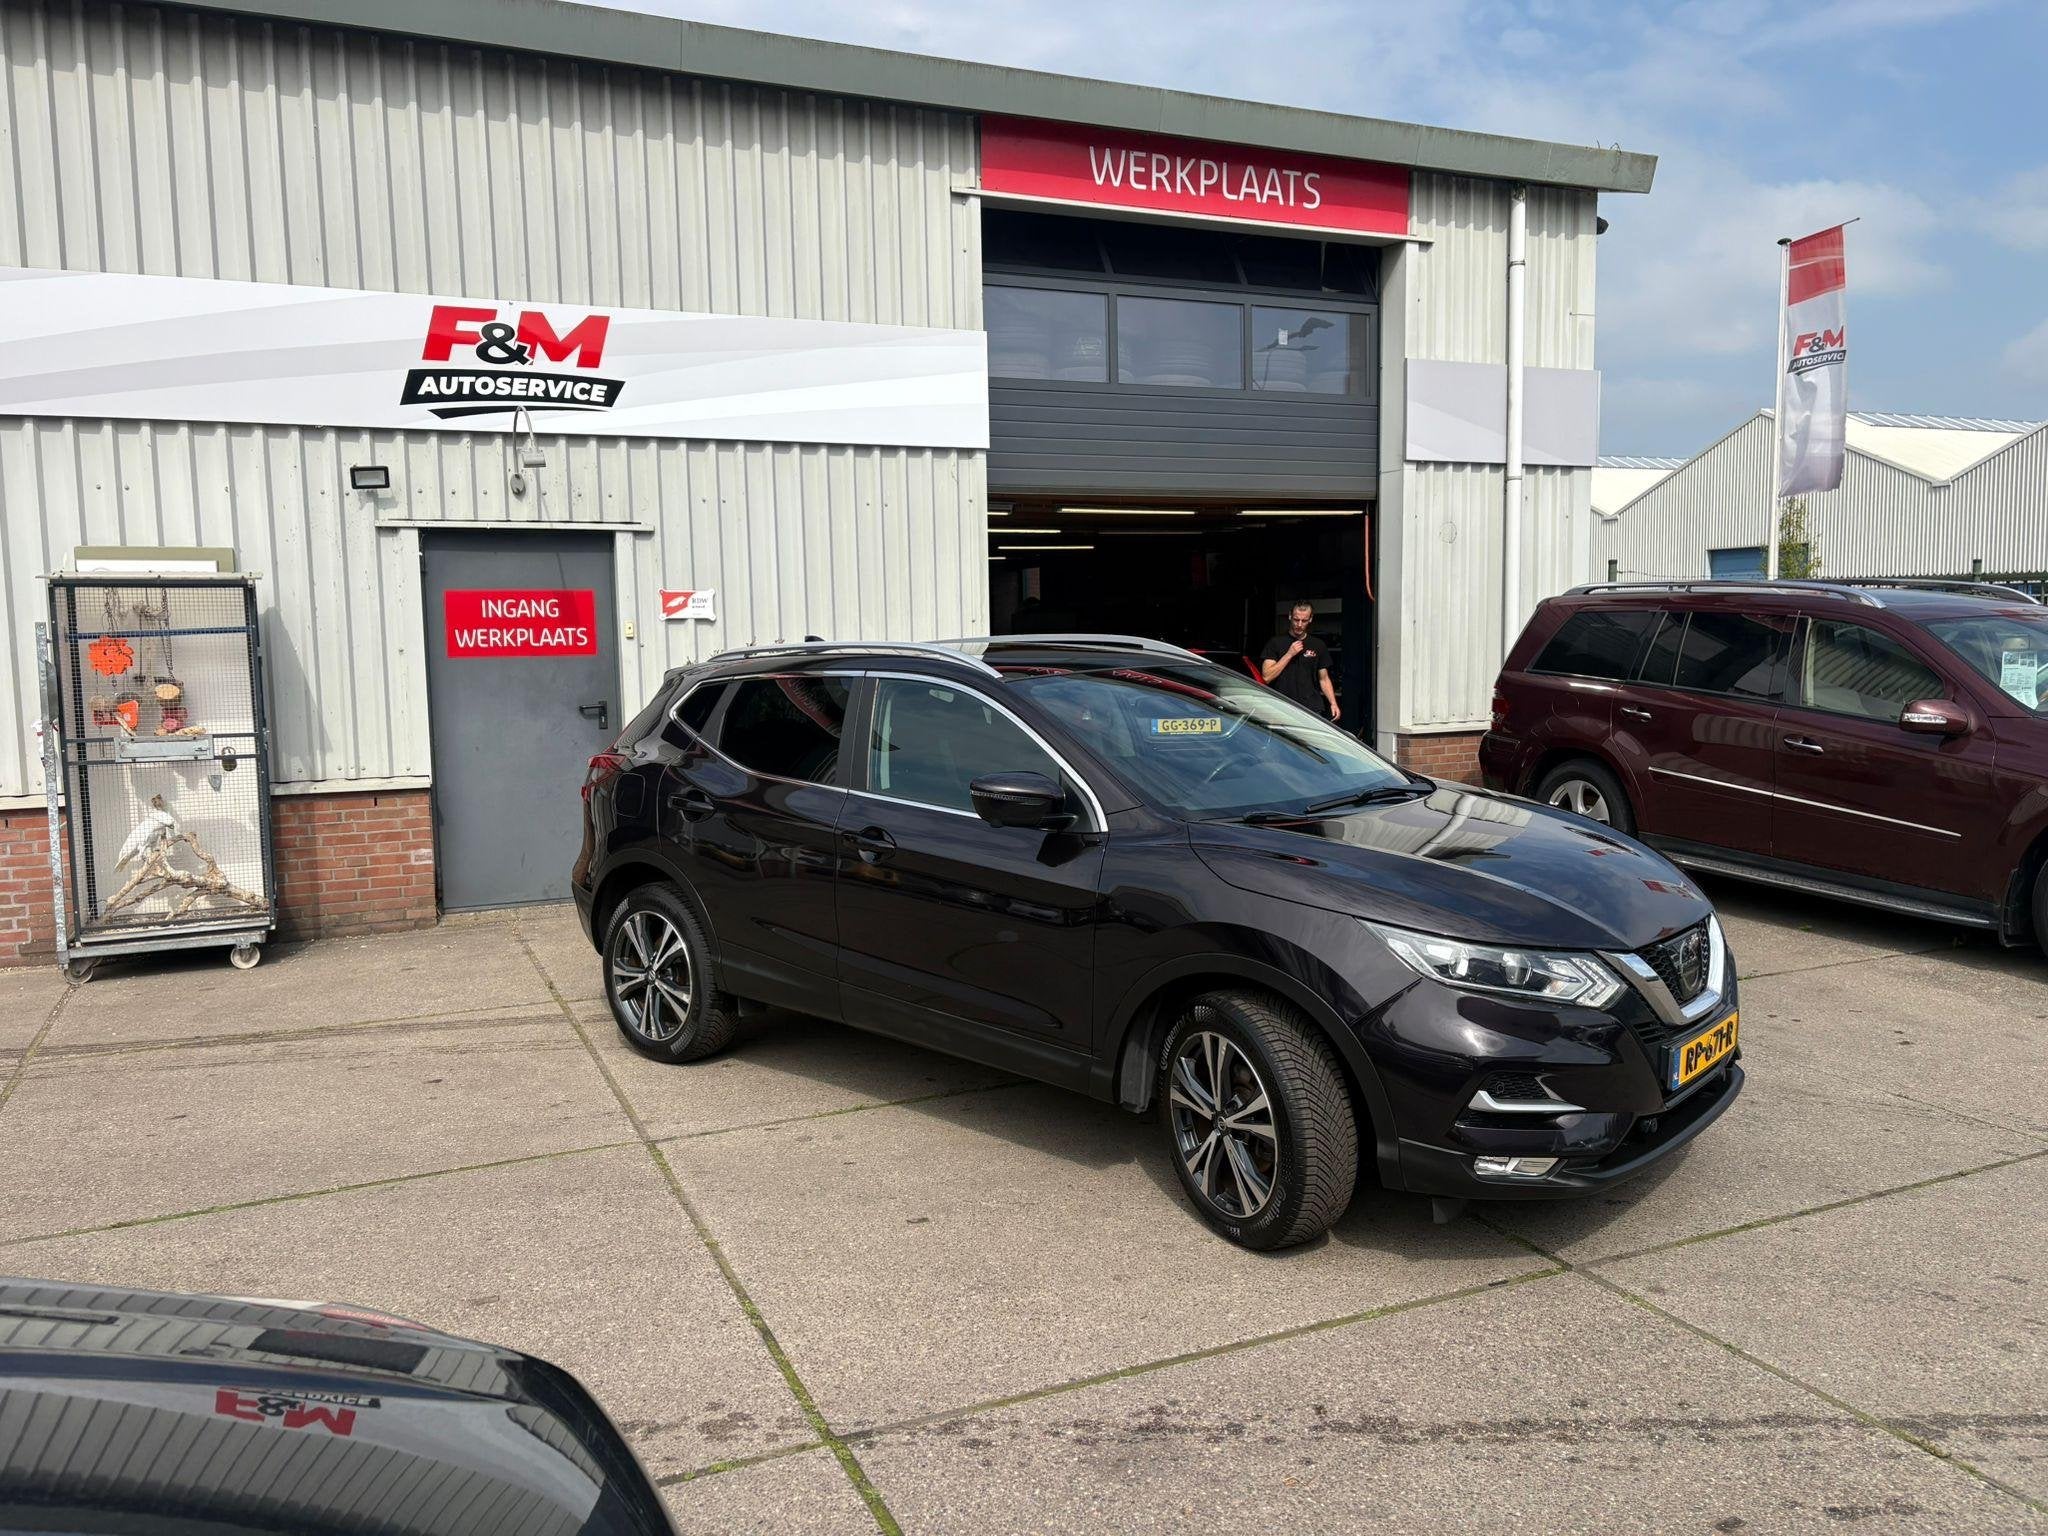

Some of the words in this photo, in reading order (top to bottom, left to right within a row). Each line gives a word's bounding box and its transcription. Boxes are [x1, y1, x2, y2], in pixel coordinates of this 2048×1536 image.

[1089, 146, 1321, 209] WERKPLAATS
[422, 305, 610, 368] F&M
[1793, 325, 1844, 356] F&M
[1791, 352, 1844, 370] AUTOSERVIC
[417, 376, 607, 402] AUTOSERVICE
[481, 599, 560, 618] INGANG
[455, 627, 588, 648] WERKPLAATS
[1162, 719, 1217, 731] GG-369-P
[1685, 1021, 1734, 1076] RP-671-R
